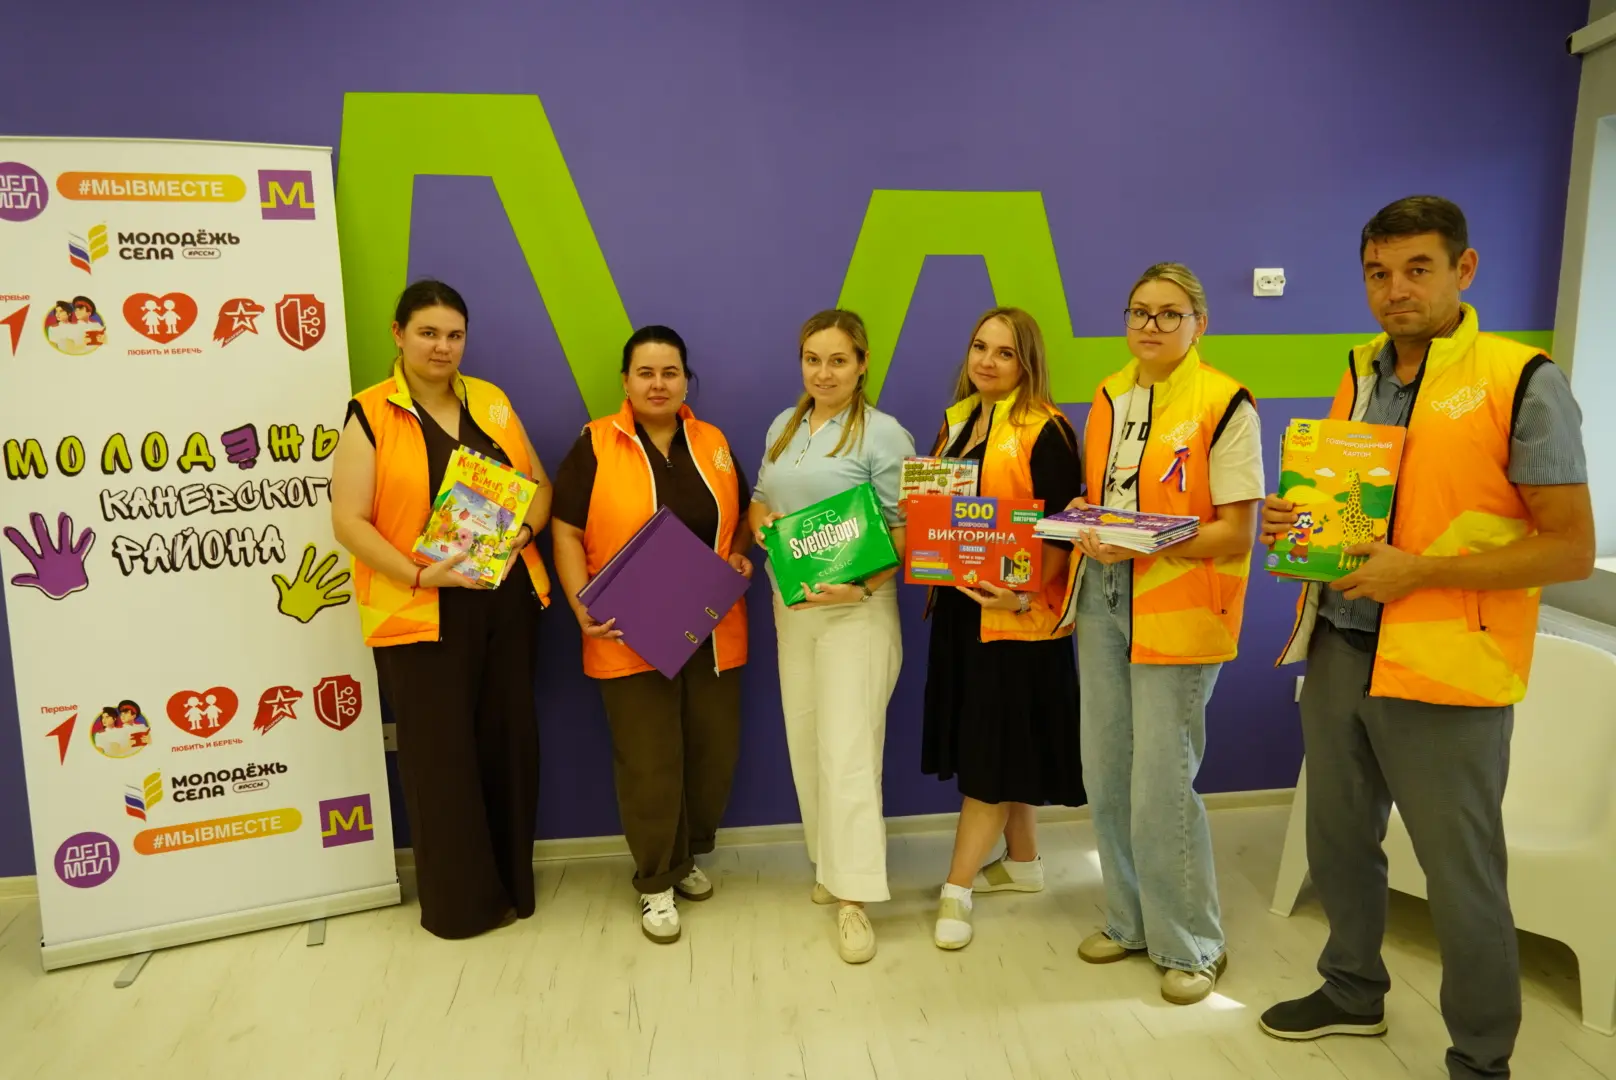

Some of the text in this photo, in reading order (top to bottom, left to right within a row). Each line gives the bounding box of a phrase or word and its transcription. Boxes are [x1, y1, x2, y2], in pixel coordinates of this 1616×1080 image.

[78, 178, 225, 198] #МЫВМЕСТЕ
[117, 229, 241, 247] МОЛОДЁЖЬ
[119, 247, 174, 261] СЕЛА
[0, 293, 30, 303] ервые
[127, 346, 203, 357] ЛЮБИТЬ И БЕРЕЧЬ
[99, 475, 334, 521] КАНЕВСКОГ
[954, 502, 994, 519] 500
[788, 516, 860, 560] SvetoCopy
[927, 528, 1018, 544] ВИКТОРИНА
[111, 524, 287, 576] РАЙОНА
[817, 560, 853, 577] CLASSIC
[40, 703, 78, 715] Первые
[171, 738, 243, 753] ЛЮБИТЬ И БЕРЕЧЬ
[171, 761, 288, 788] МОЛОДЁЖЬ
[172, 784, 226, 803] СЕЛА
[152, 815, 283, 849] #МЫВМЕСТЕ
